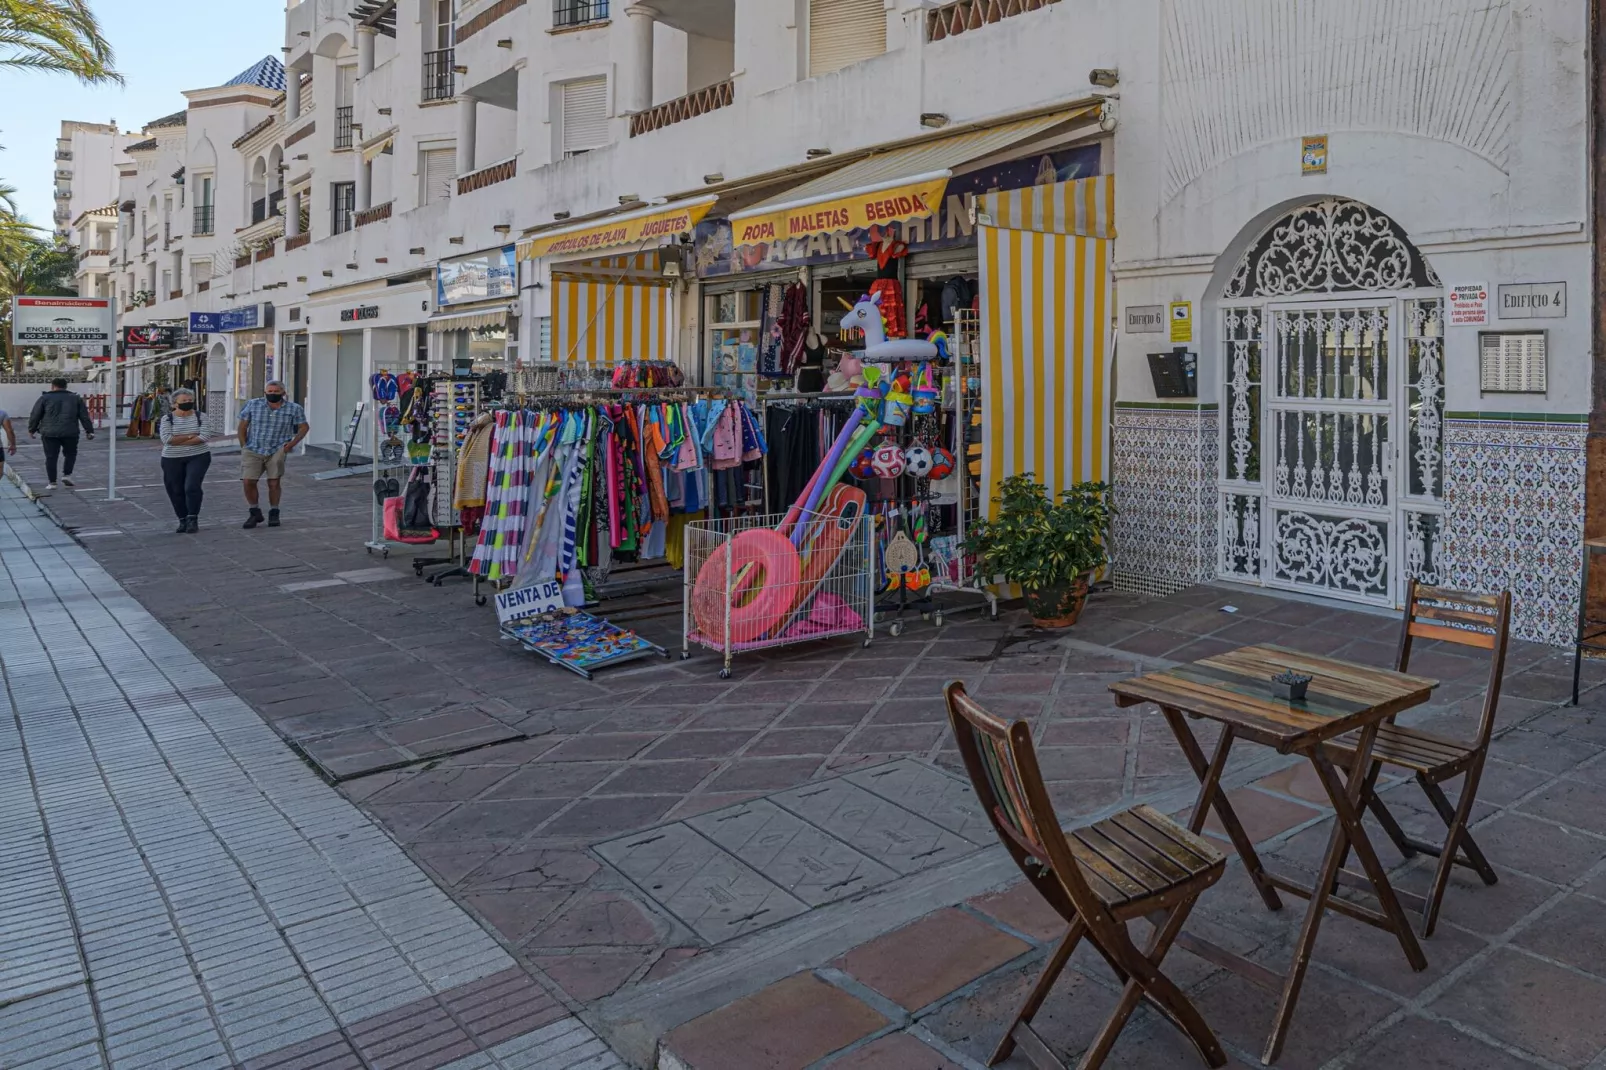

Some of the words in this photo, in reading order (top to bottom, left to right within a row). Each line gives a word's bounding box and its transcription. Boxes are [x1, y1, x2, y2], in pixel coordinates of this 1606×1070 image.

[547, 236, 589, 252] ARTÍCULOS
[590, 233, 601, 245] DE
[602, 228, 627, 243] PLAYA
[640, 215, 688, 236] JUGUETES
[742, 222, 775, 241] ROPA
[789, 208, 849, 234] MALETAS
[1553, 290, 1561, 306] 4
[1156, 313, 1161, 324] 6
[498, 587, 541, 609] VENTA
[543, 582, 560, 598] DE
